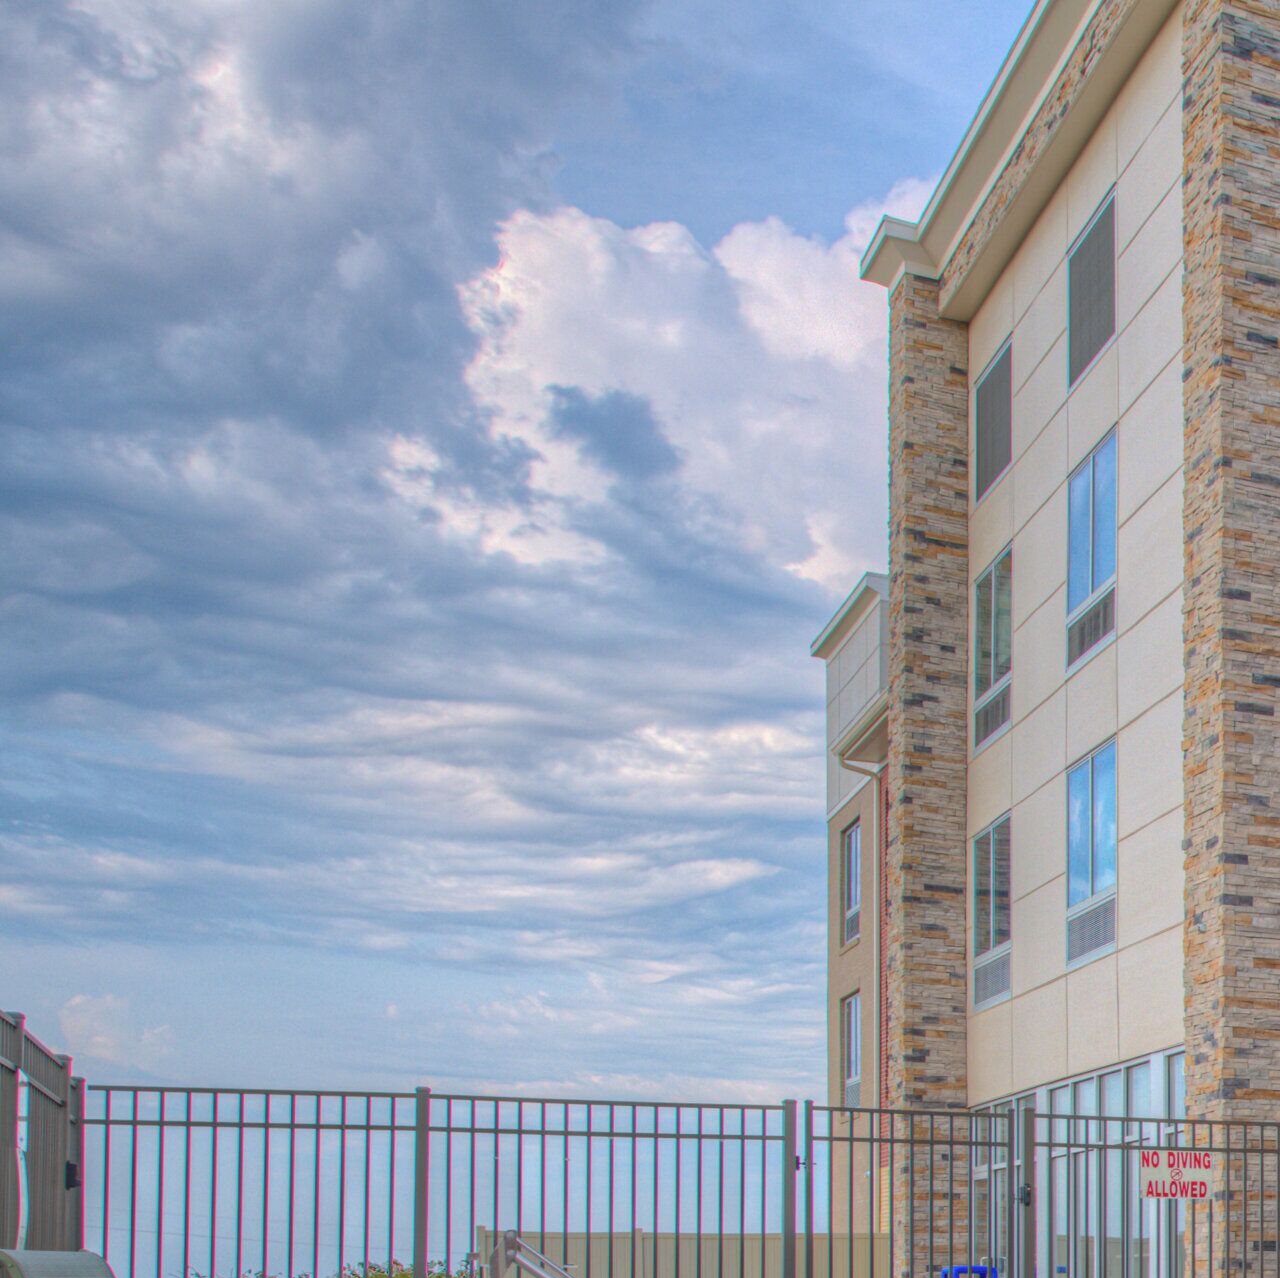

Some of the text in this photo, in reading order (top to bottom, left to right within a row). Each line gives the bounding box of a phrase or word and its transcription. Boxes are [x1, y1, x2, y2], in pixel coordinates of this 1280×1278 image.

[1141, 1151, 1211, 1169] NO DIVING
[1146, 1180, 1208, 1198] ALLOWED
